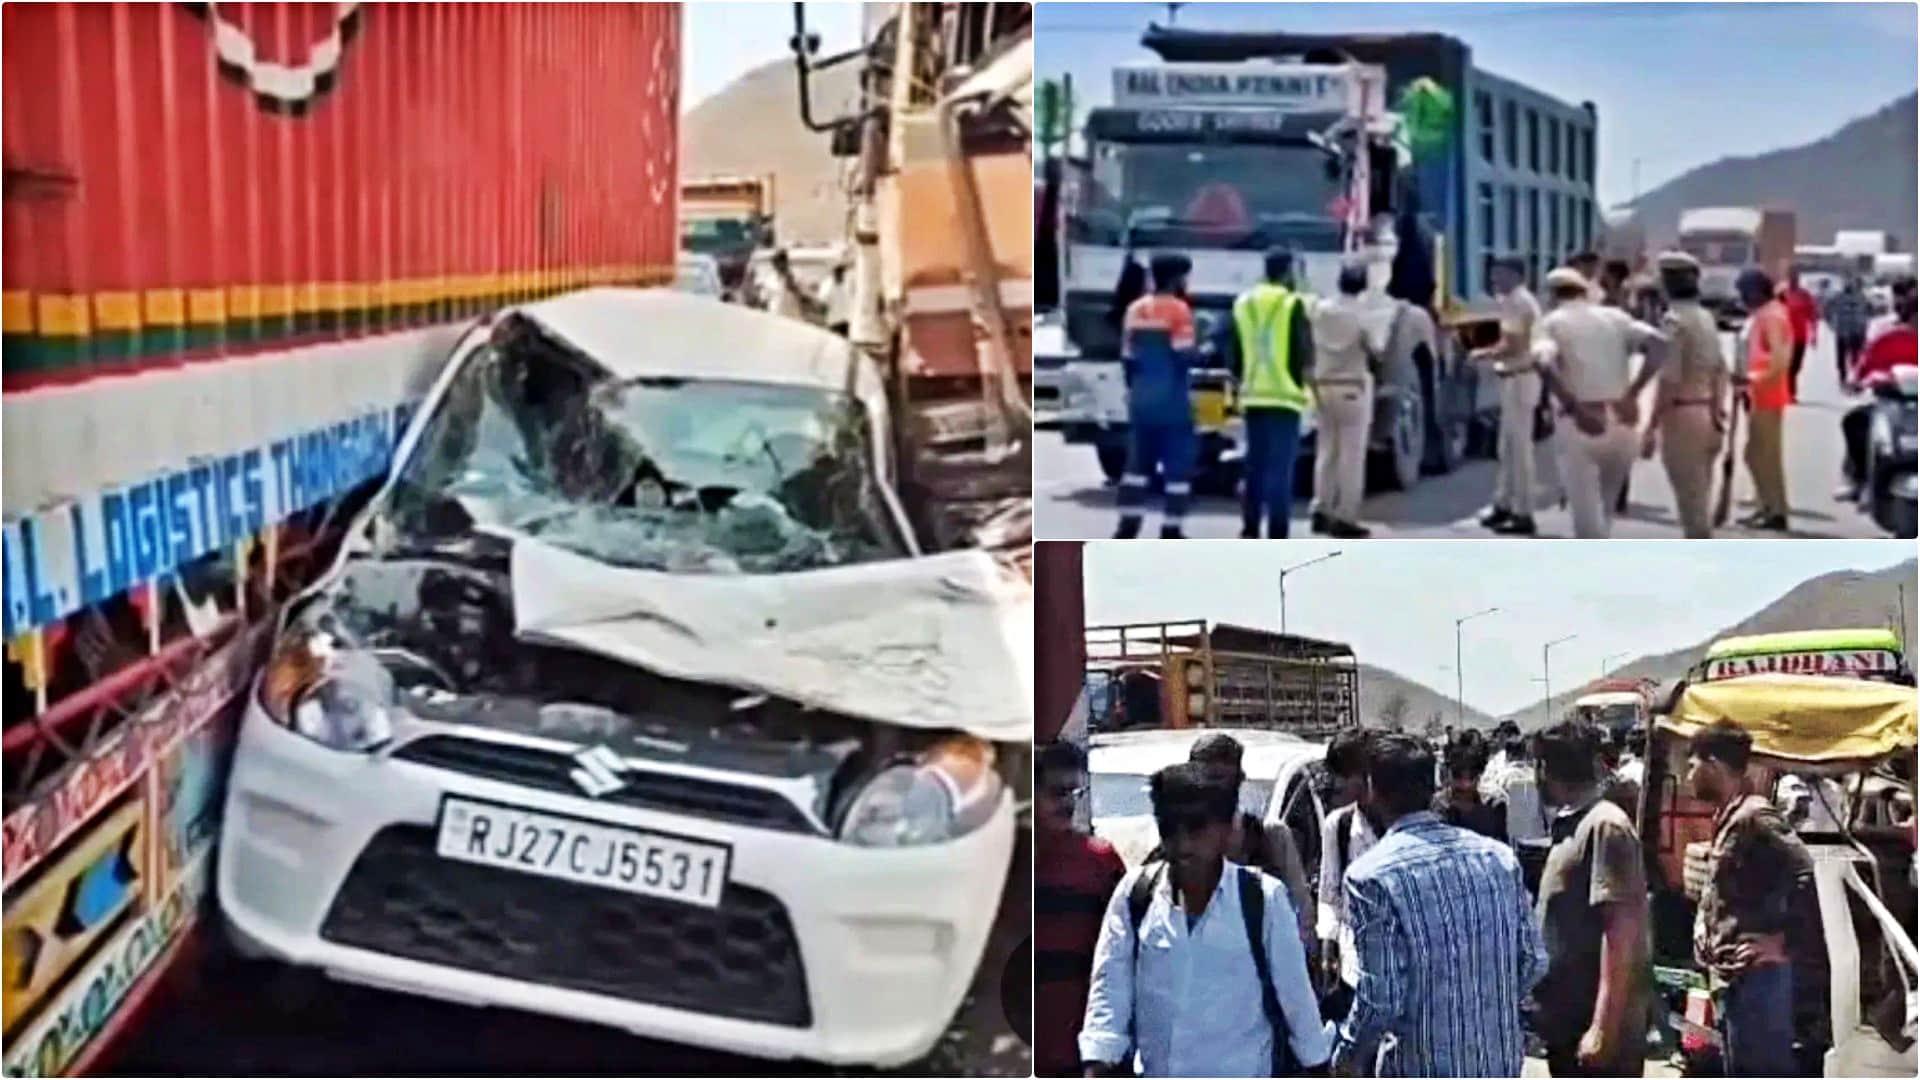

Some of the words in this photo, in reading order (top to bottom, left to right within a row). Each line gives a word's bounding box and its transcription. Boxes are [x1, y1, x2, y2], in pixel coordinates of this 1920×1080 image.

[1166, 73, 1230, 96] INDIA
[70, 446, 264, 606] LOGISTICS
[467, 815, 714, 897] RJ27CJ5531
